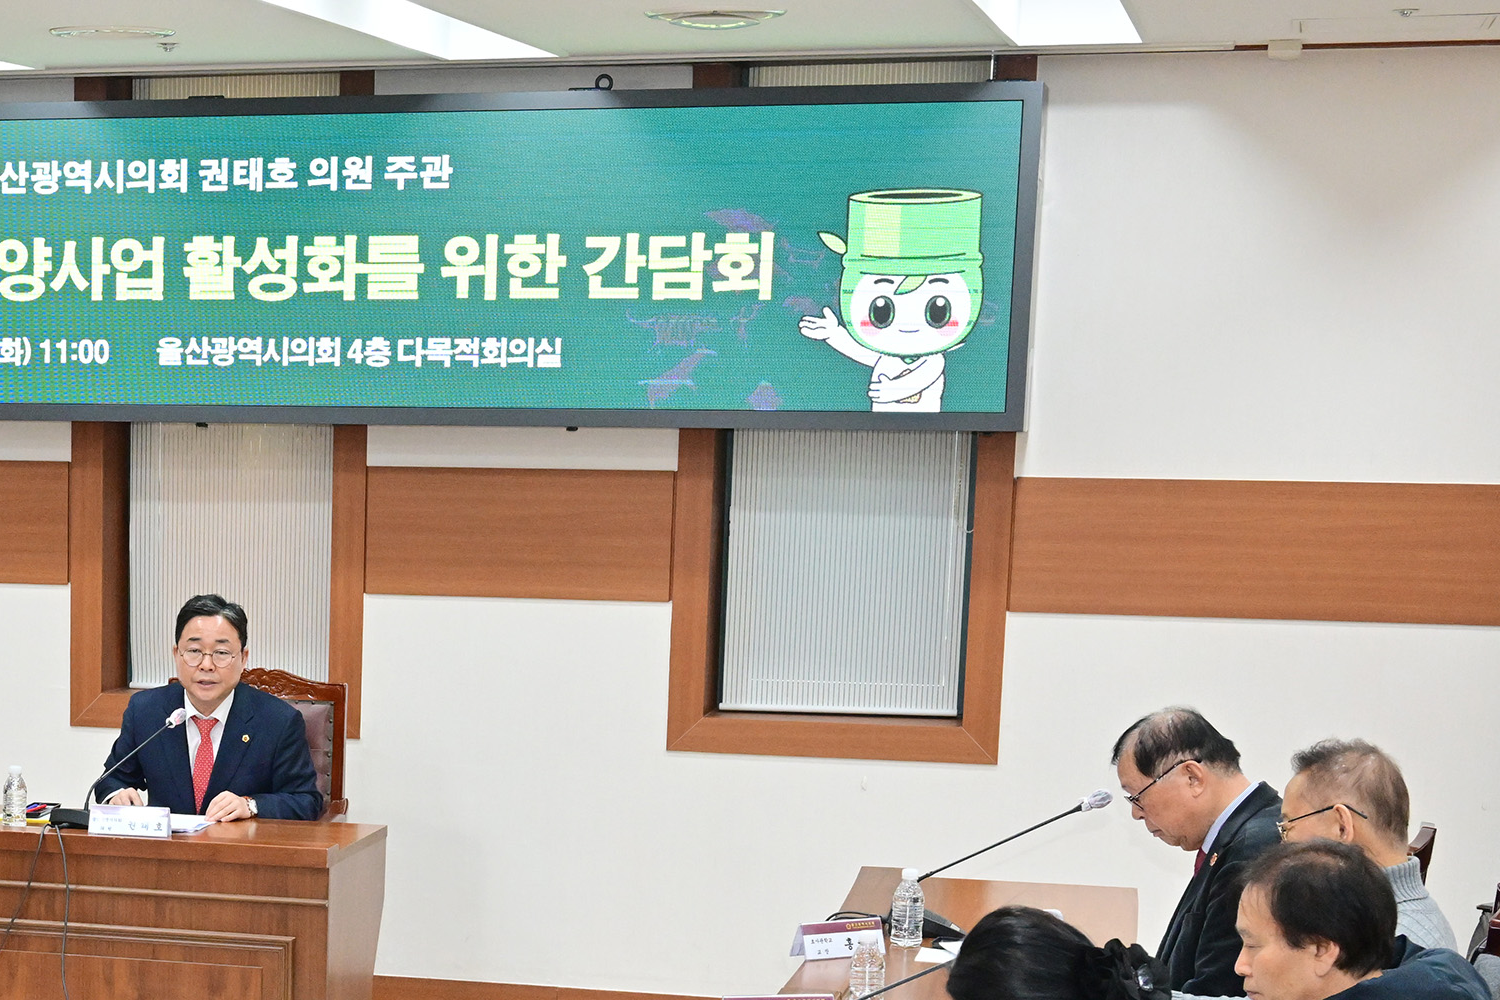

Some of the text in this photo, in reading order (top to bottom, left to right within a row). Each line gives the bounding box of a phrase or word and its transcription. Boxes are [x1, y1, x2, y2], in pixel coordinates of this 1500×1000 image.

[198, 157, 299, 192] 권태호
[307, 156, 373, 191] 의원
[384, 154, 454, 191] 주관
[182, 234, 426, 302] 활성화를
[440, 233, 568, 301] 위한
[582, 231, 775, 301] 간담회
[39, 338, 110, 365] 11:00
[156, 336, 563, 368] 울산광역시의회 4층 다목적회의실
